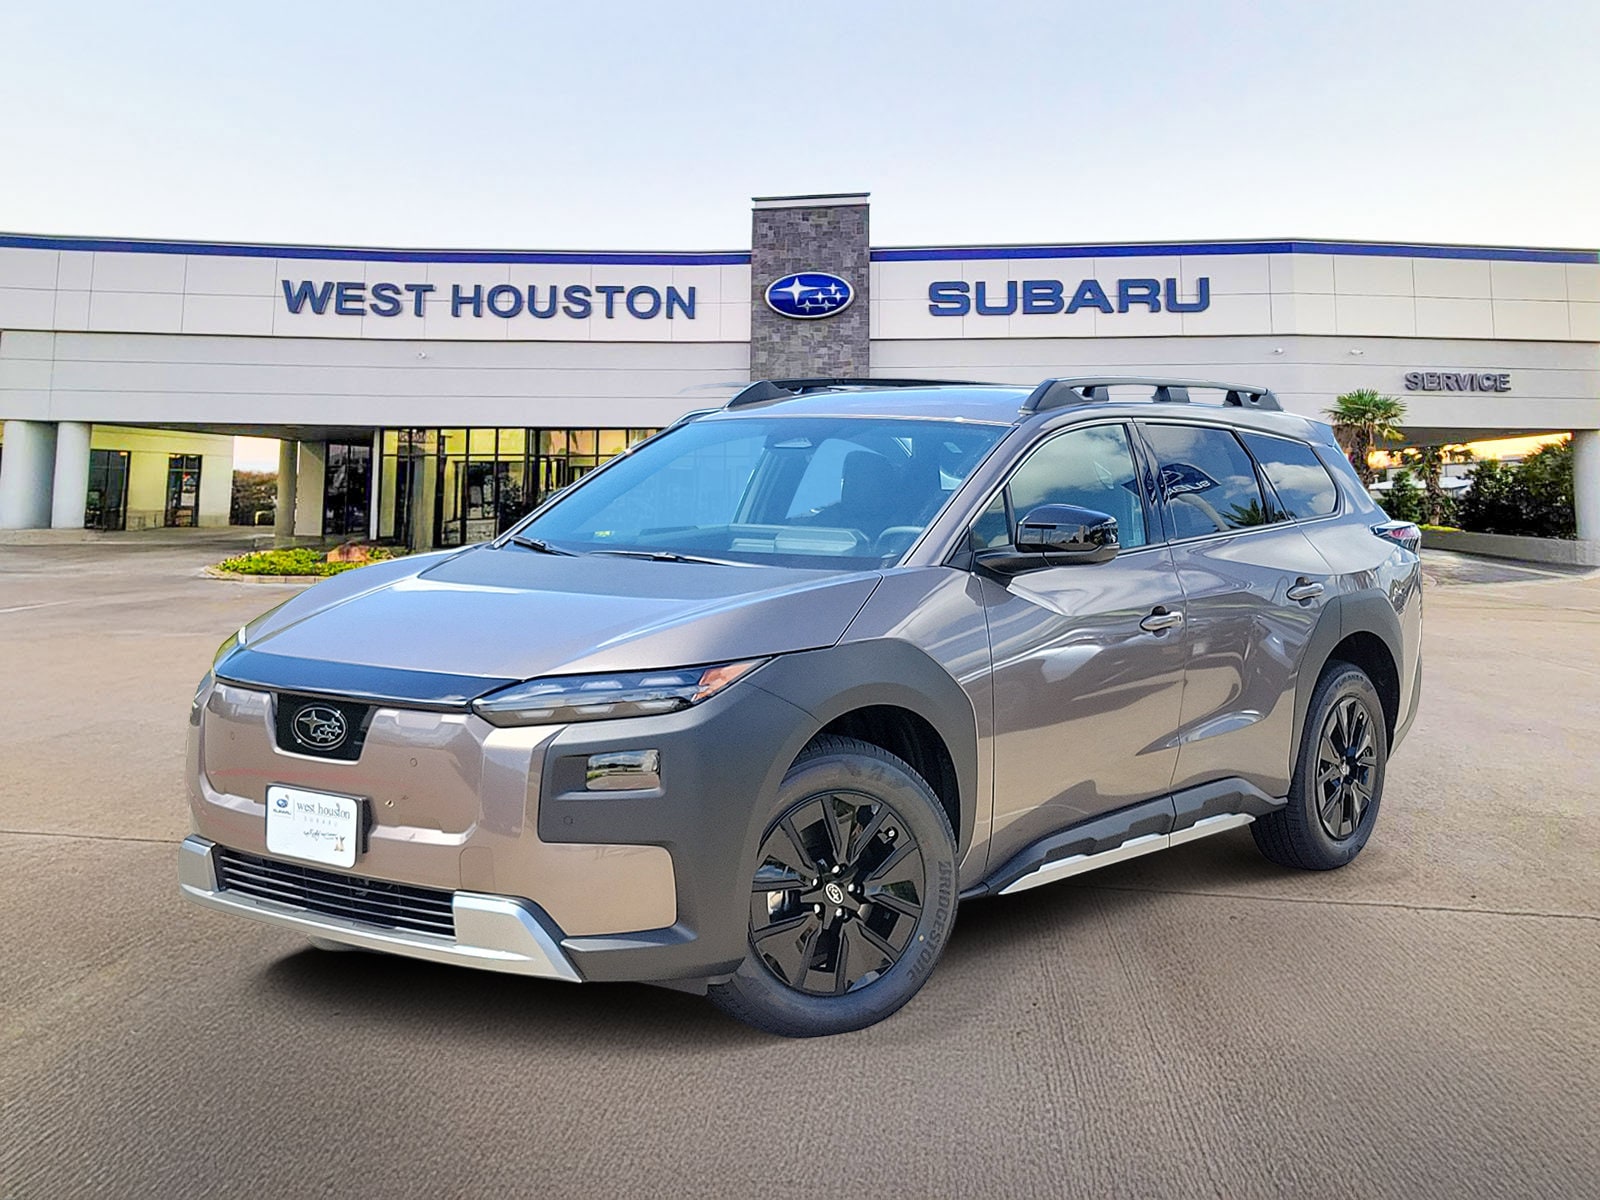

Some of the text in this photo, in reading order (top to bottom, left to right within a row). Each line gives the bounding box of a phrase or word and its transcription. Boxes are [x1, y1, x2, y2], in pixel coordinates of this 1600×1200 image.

[282, 280, 696, 319] WEST HOUSTON
[928, 277, 1211, 316] SUBARU
[1404, 372, 1512, 392] SERVICE
[318, 803, 351, 820] houston
[906, 860, 953, 983] BRIDGESTONE
